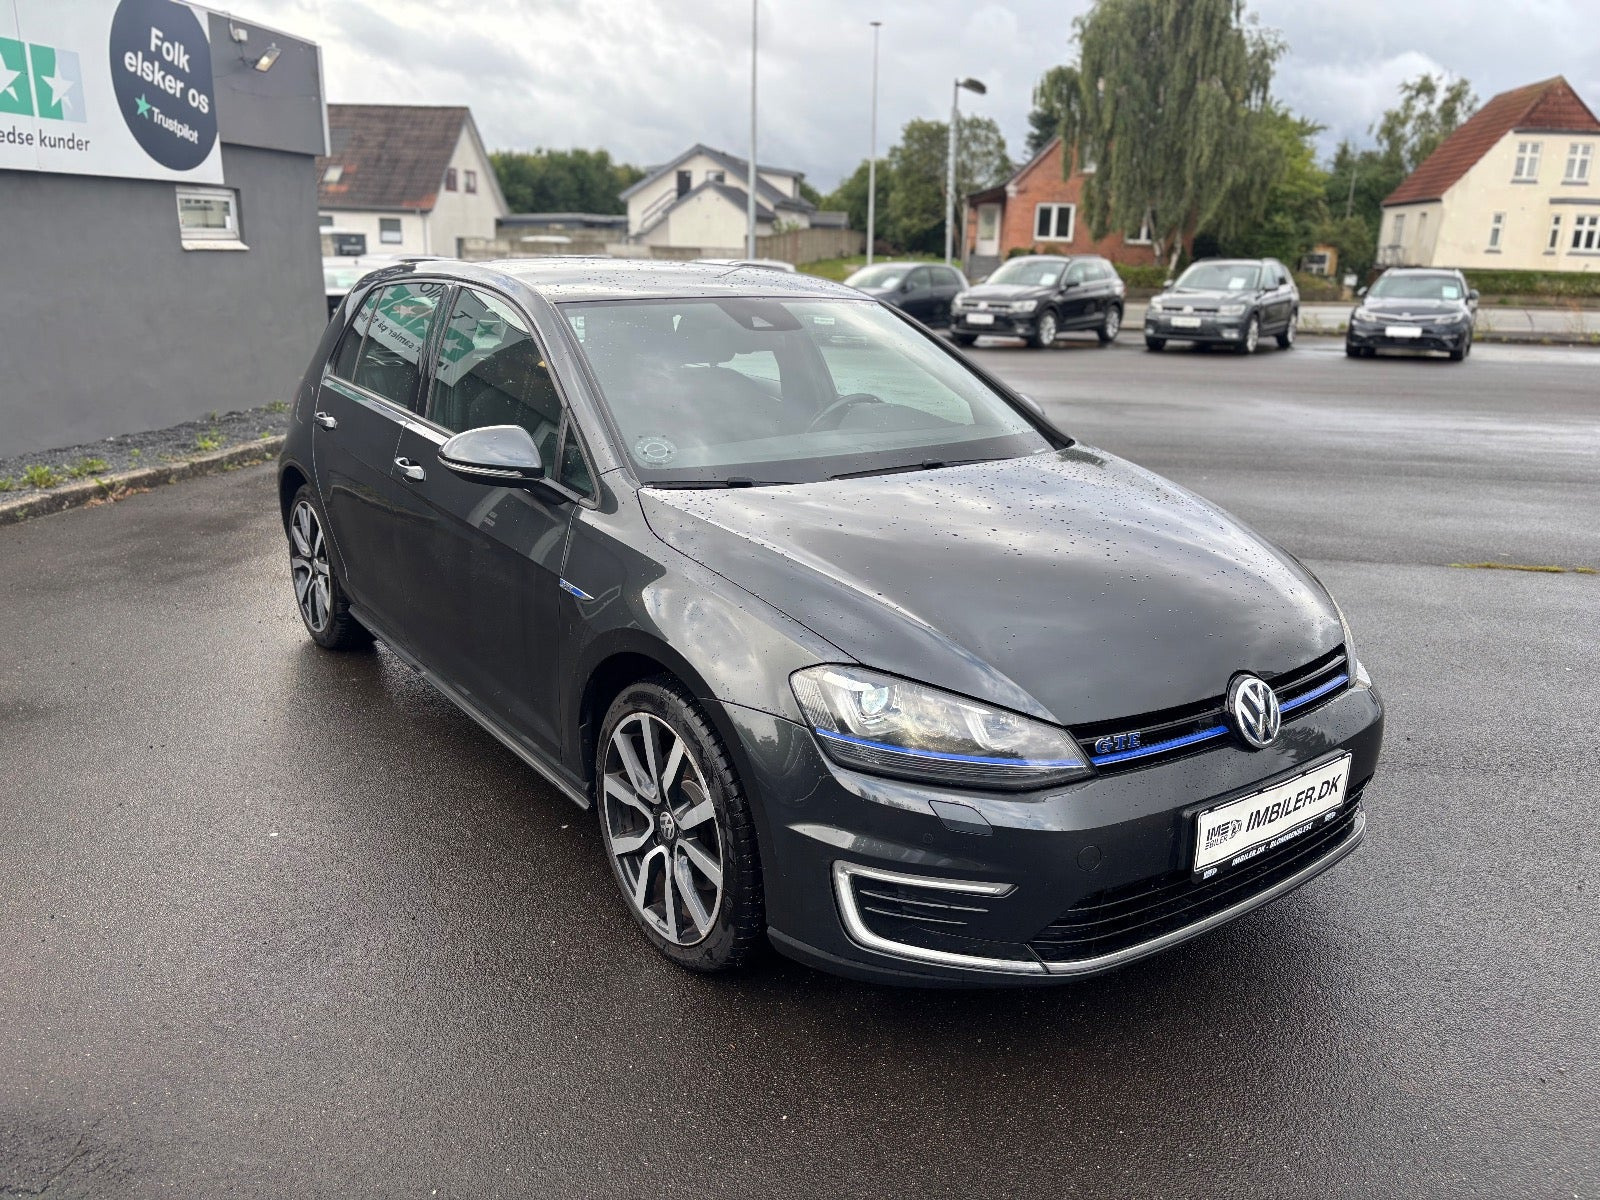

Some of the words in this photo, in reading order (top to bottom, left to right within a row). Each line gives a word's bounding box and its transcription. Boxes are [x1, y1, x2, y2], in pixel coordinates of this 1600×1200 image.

[150, 26, 191, 74] Folk
[124, 50, 185, 97] elsker
[188, 86, 209, 115] os
[39, 128, 91, 152] kunder
[151, 107, 200, 145] Trustpilot
[1094, 731, 1141, 755] GTE
[1246, 774, 1342, 833] IMBILER.DK
